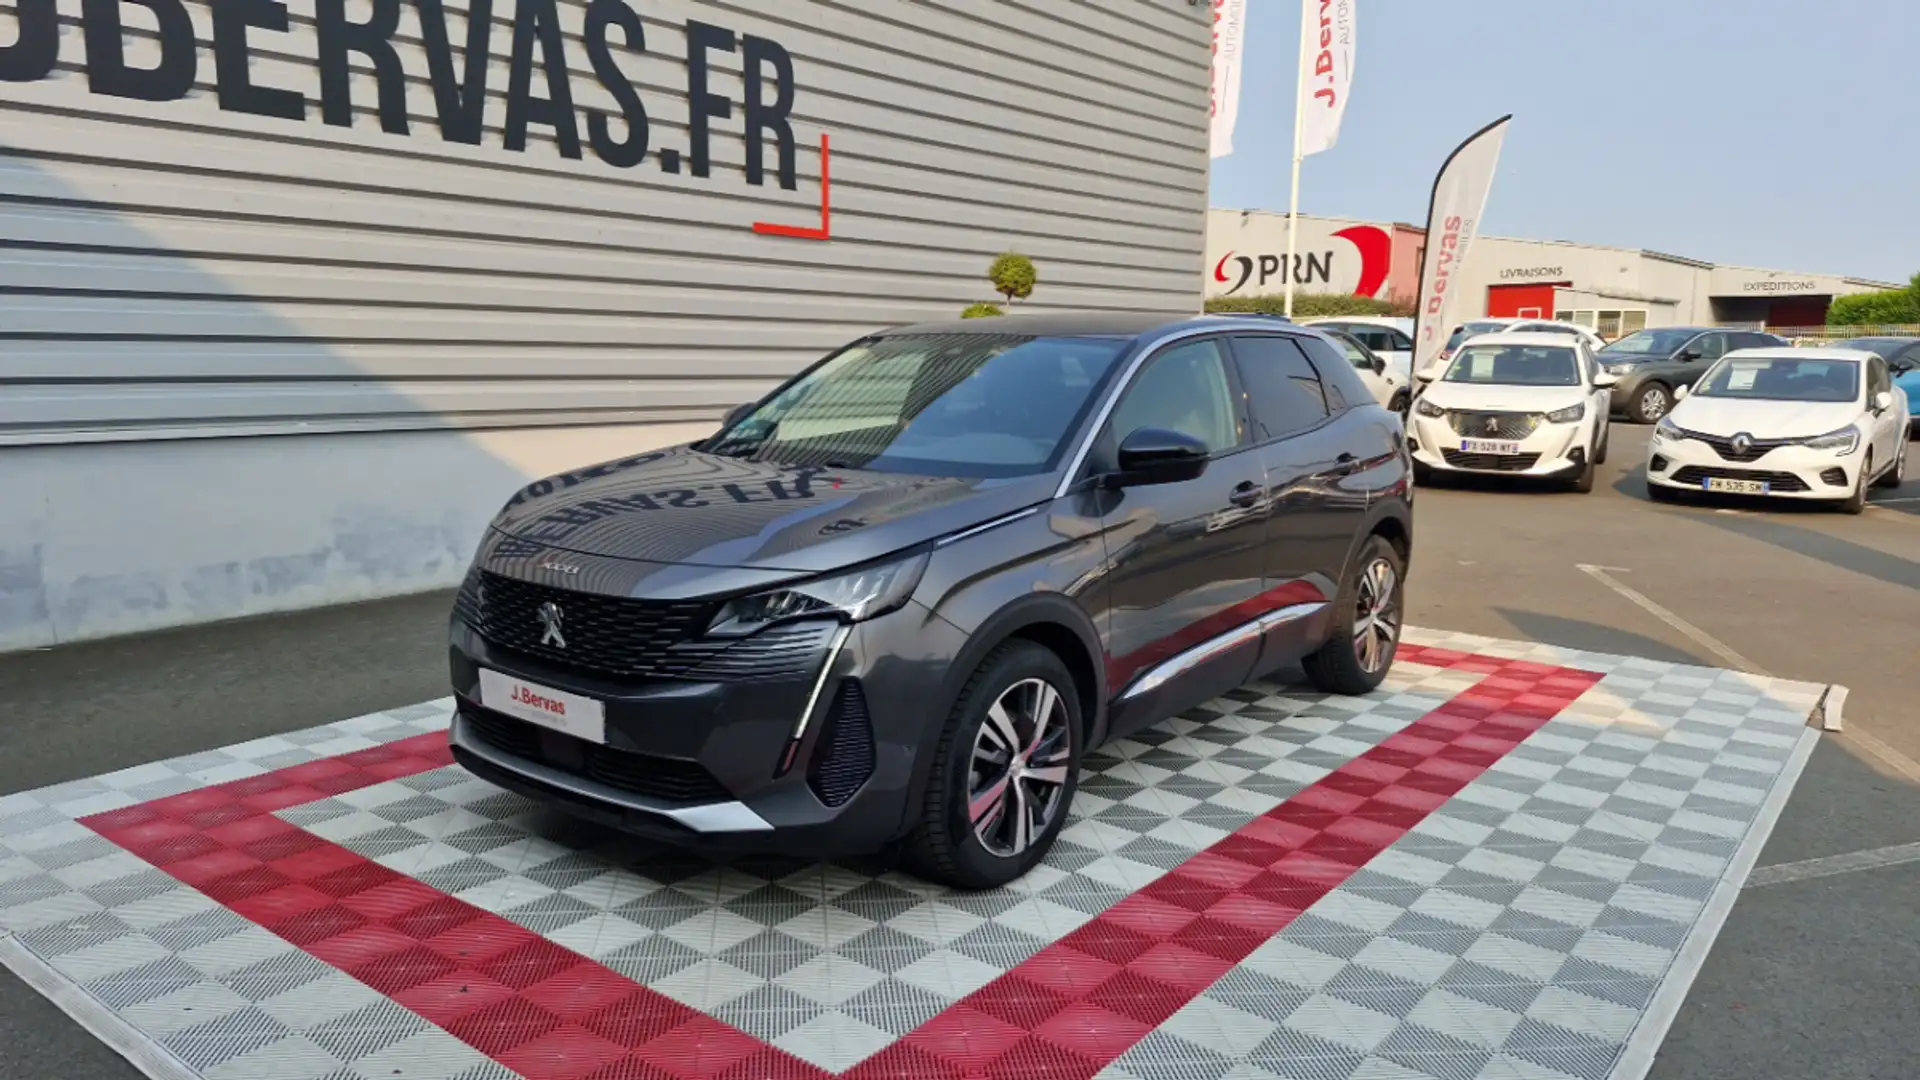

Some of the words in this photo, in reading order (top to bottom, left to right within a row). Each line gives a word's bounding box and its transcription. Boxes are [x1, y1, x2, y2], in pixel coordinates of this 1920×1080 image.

[1258, 250, 1334, 286] PRN
[1500, 265, 1564, 279] LIVRAISONS
[1743, 280, 1817, 292] EXPEDITIONS
[511, 684, 565, 715] J.Bervas
